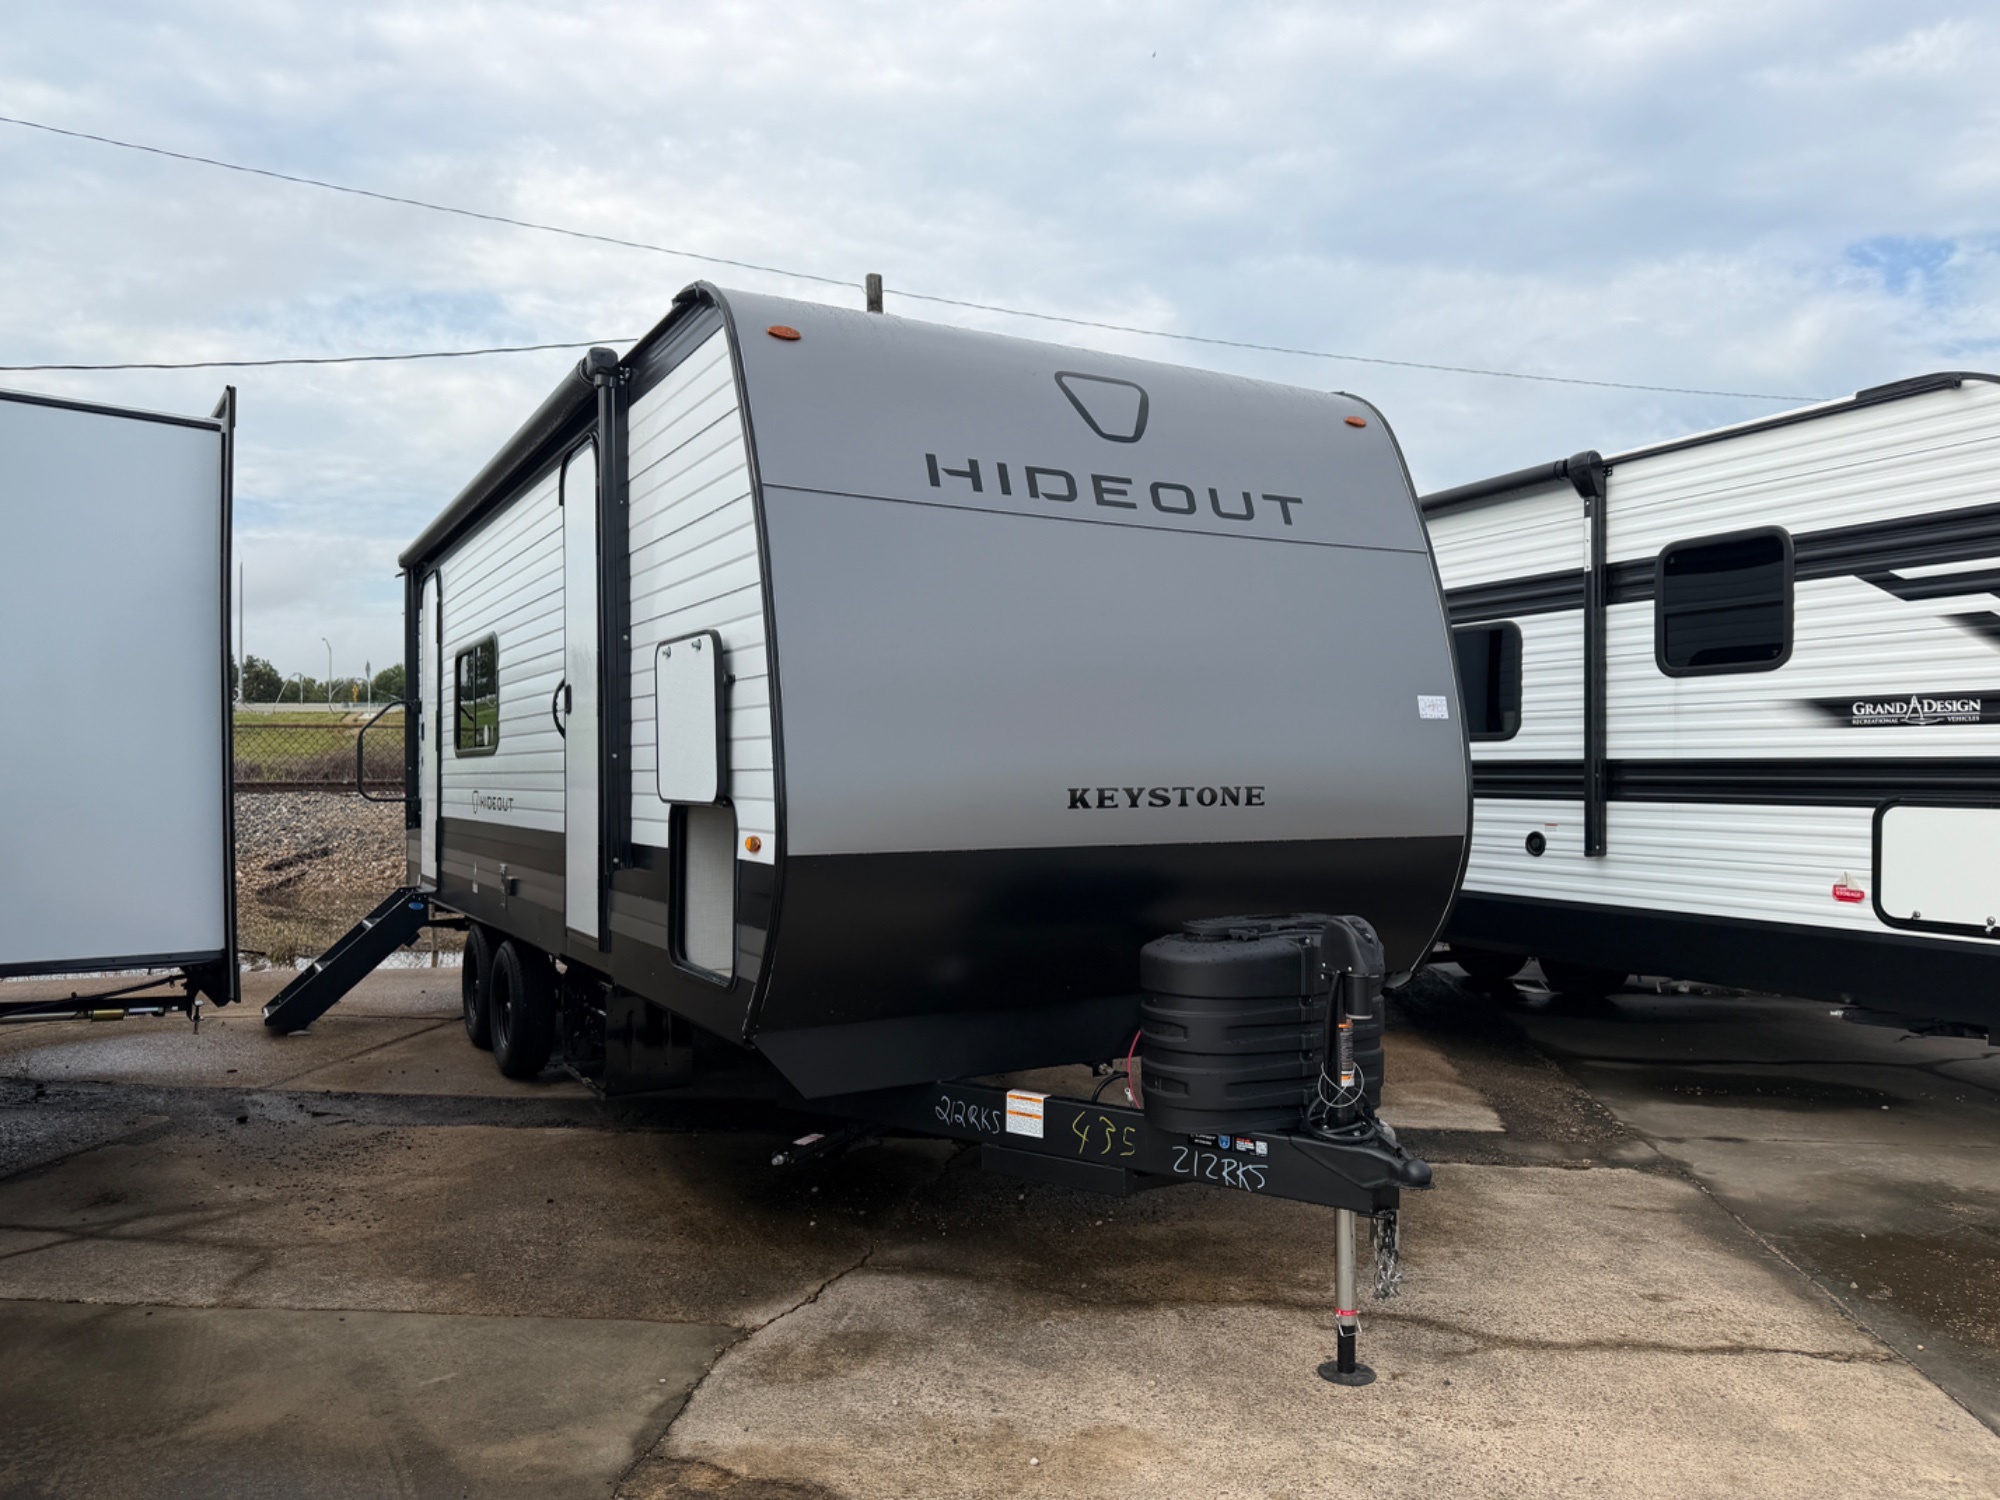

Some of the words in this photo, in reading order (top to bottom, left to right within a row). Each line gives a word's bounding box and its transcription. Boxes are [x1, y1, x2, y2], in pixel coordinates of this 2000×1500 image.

[925, 452, 1304, 526] HIDEOUT
[1852, 701, 1908, 716] GRAND
[1922, 698, 1981, 713] DESIGN
[1947, 715, 1980, 723] VEHICLES
[480, 796, 514, 812] HIDEOUT
[1067, 786, 1265, 809] KEYSTONE
[1072, 1110, 1136, 1156] 435
